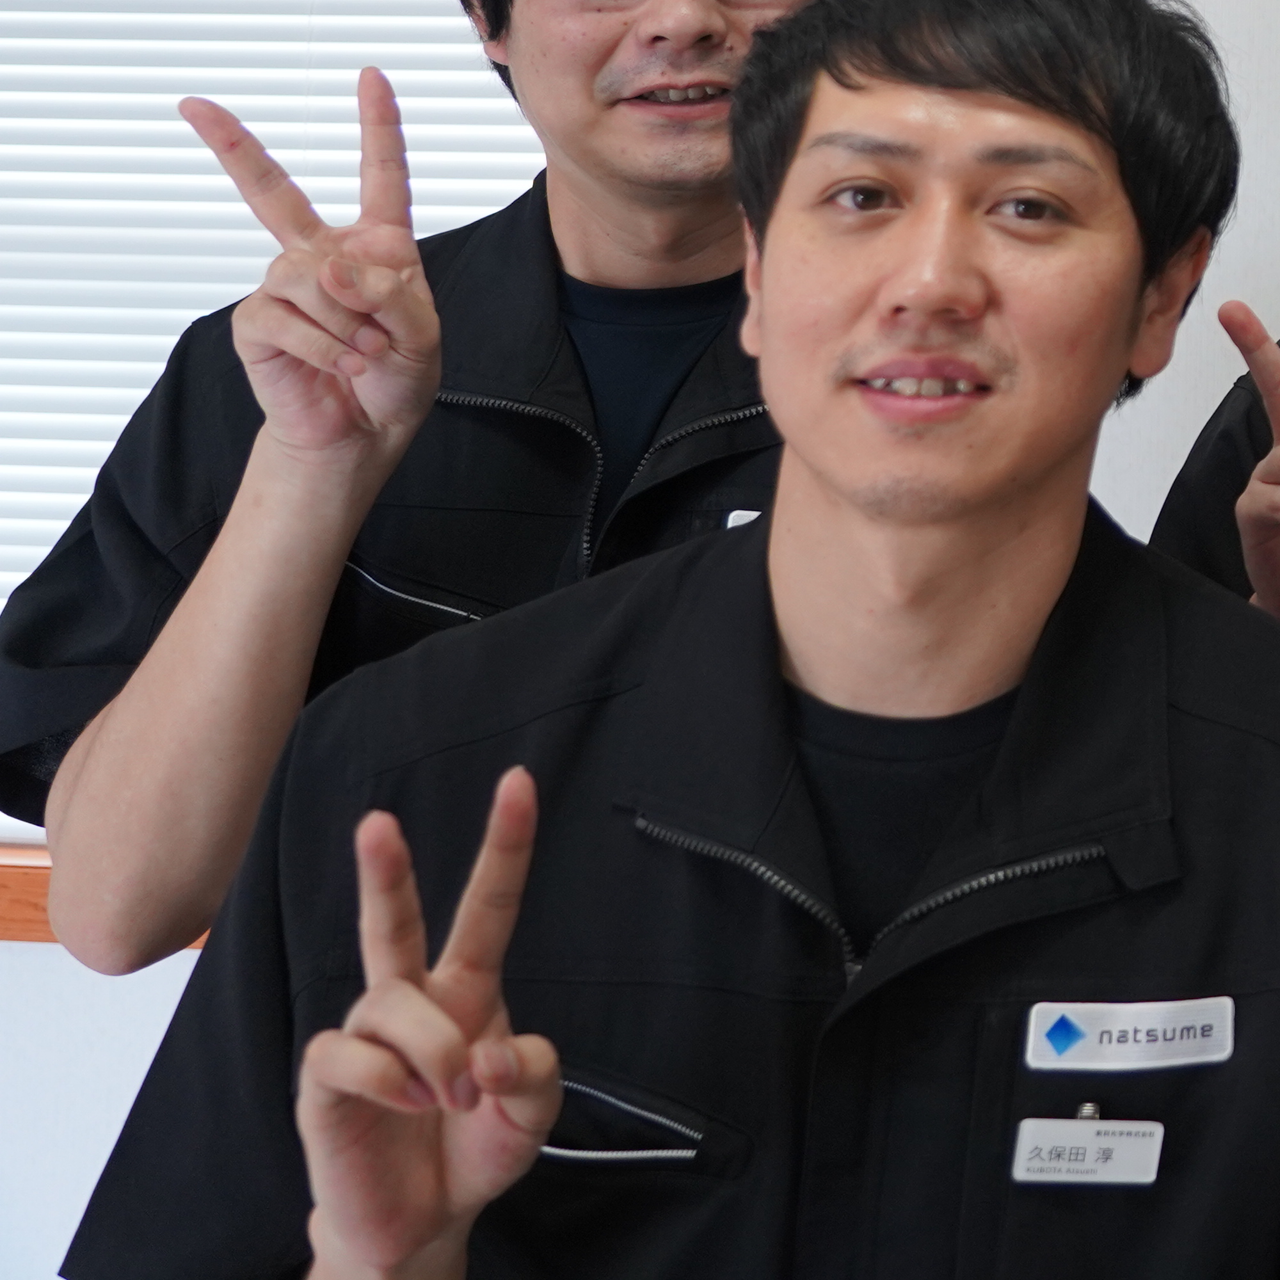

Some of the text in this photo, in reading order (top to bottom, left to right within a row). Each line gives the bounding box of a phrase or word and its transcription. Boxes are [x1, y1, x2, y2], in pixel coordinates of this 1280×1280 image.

[1099, 1023, 1214, 1045] natsume
[1027, 1145, 1115, 1163] 久保田 淳
